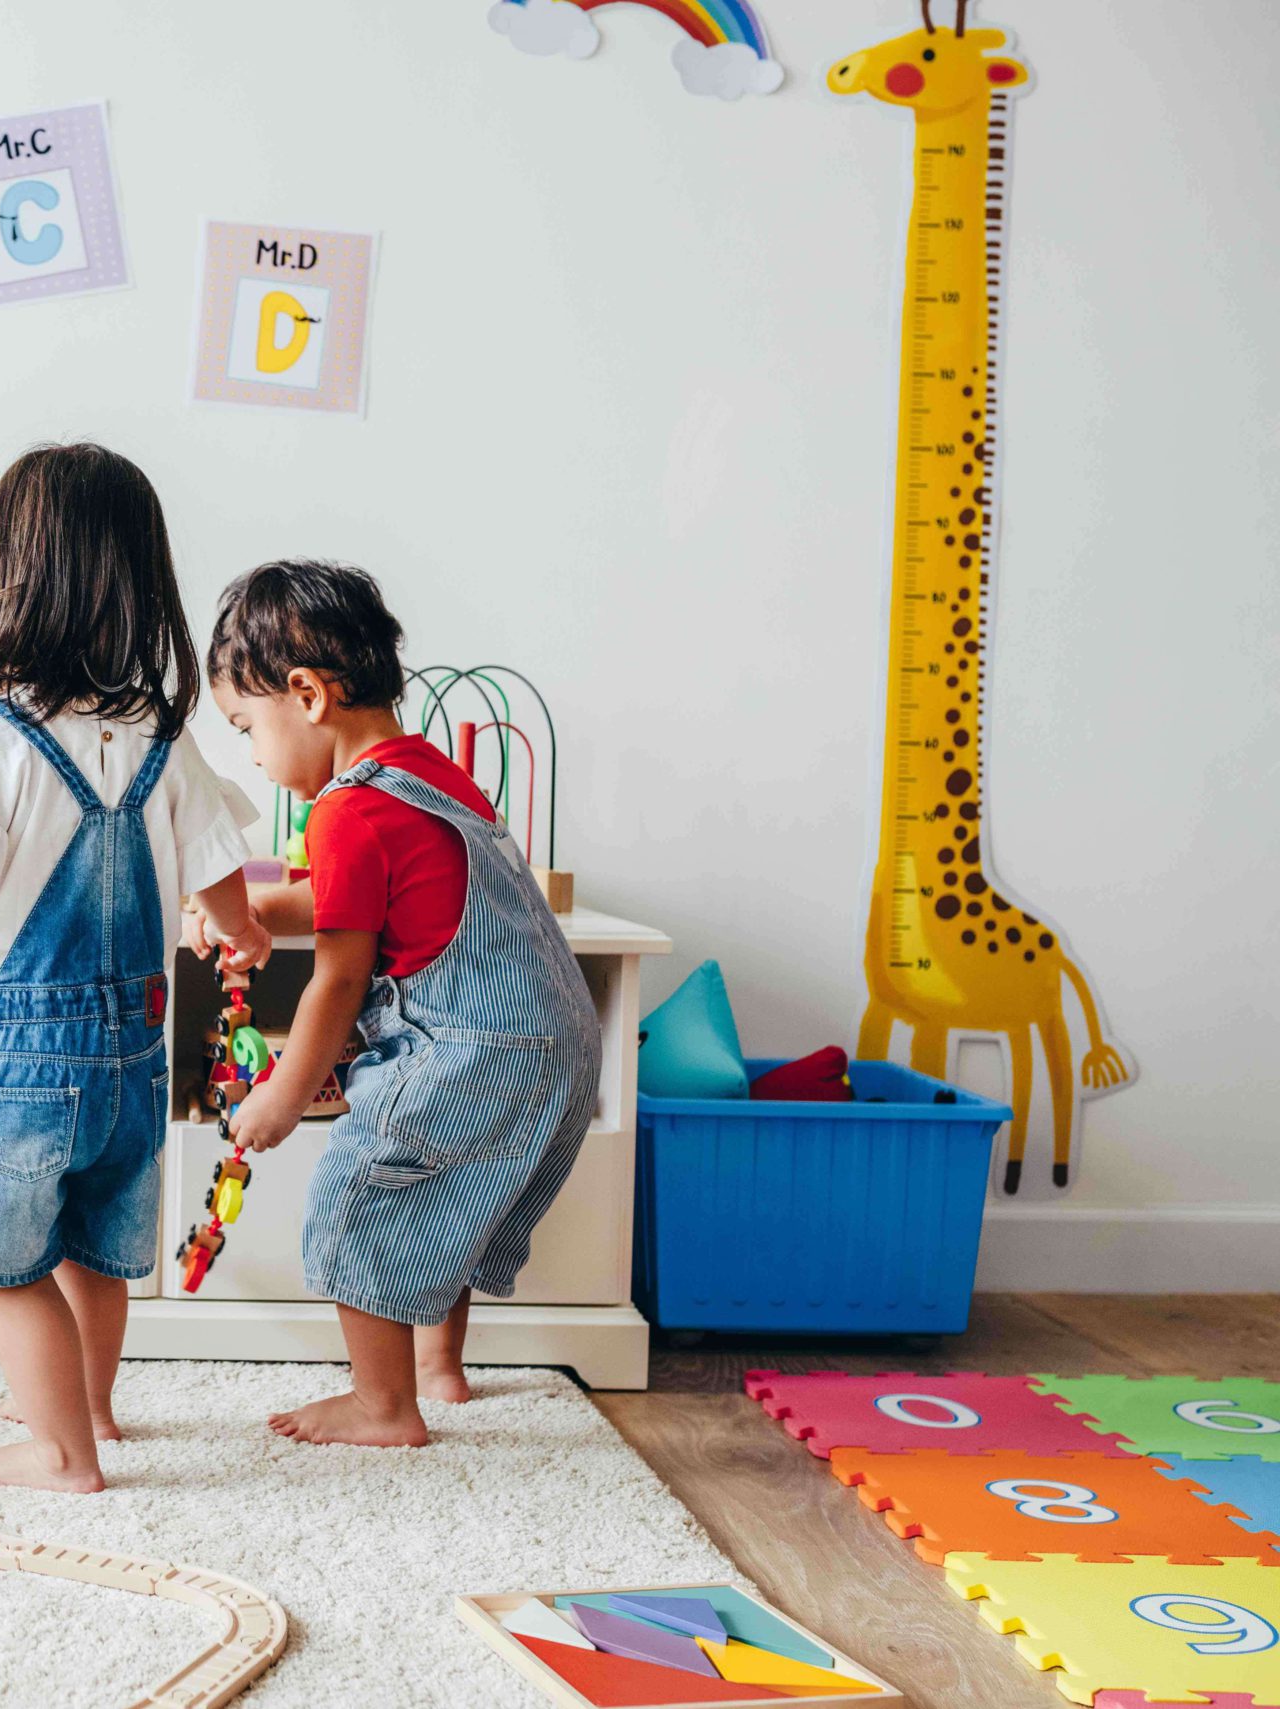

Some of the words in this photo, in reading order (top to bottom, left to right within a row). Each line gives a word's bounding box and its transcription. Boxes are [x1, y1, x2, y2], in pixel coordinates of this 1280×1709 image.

[255, 239, 318, 271] Mr.D
[255, 290, 310, 374] D
[985, 1478, 1120, 1524] 8
